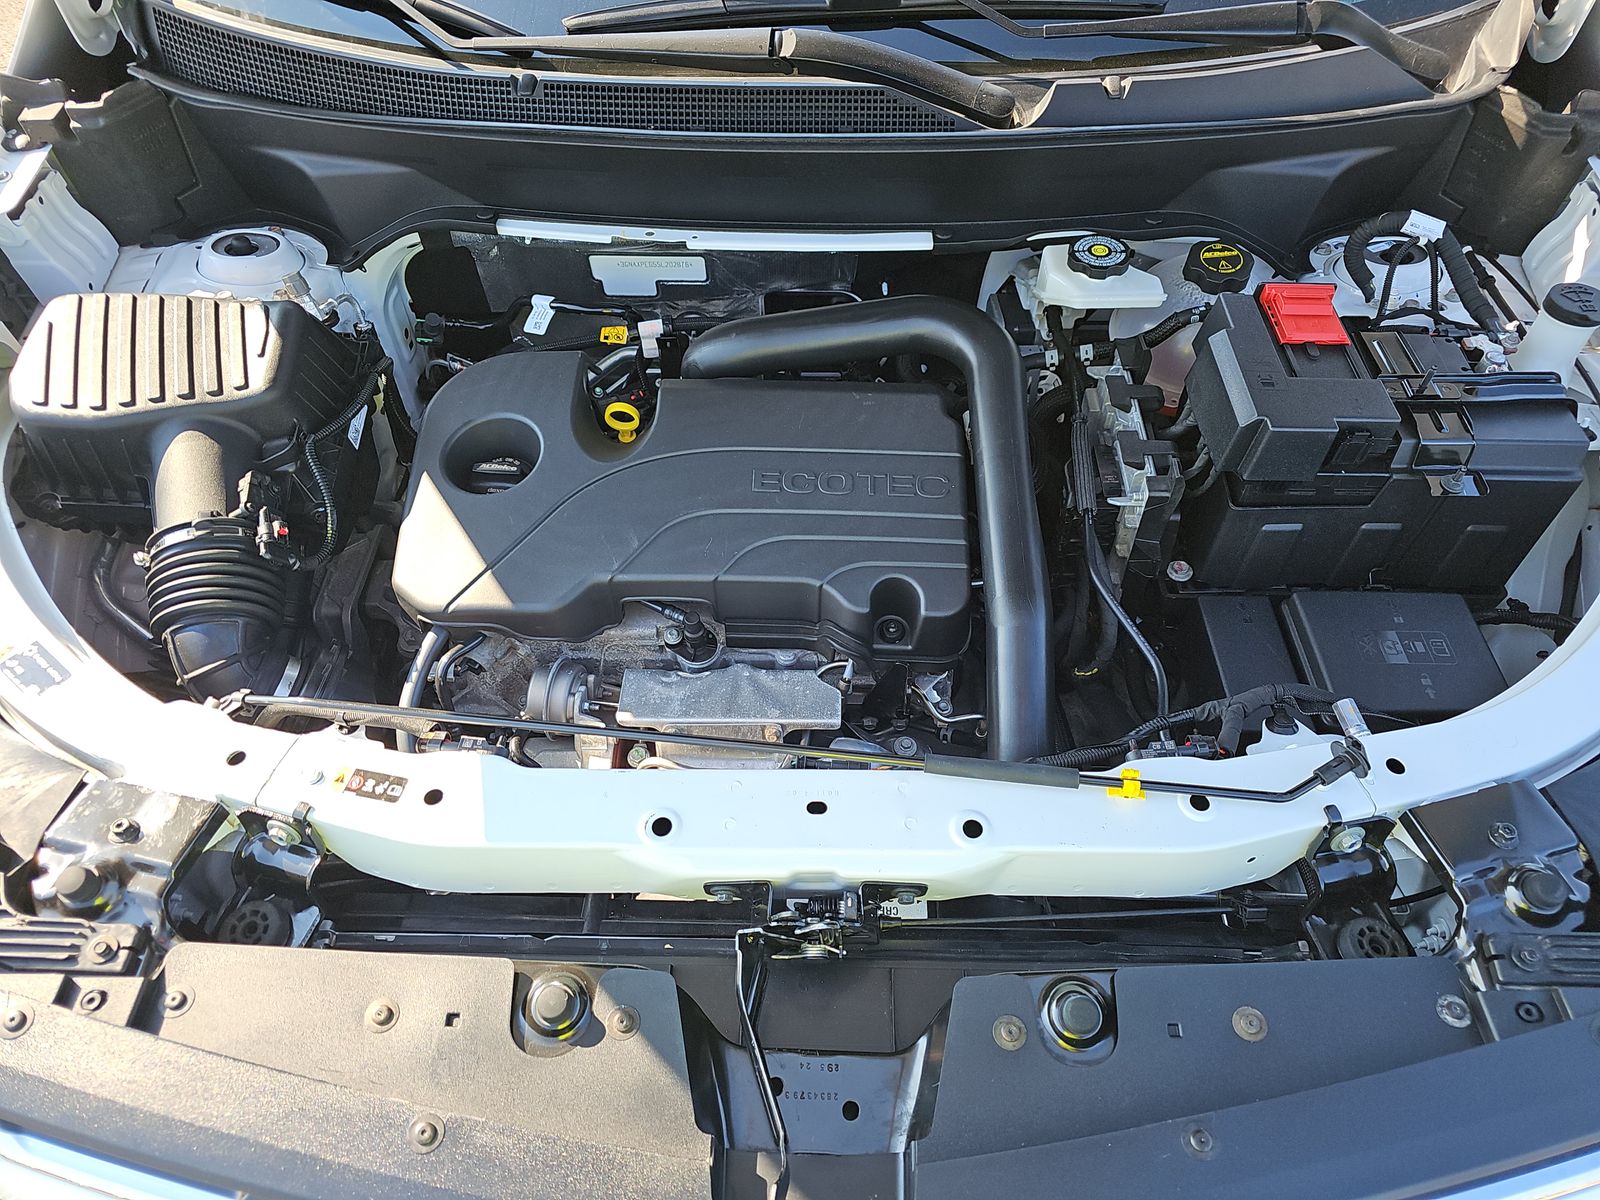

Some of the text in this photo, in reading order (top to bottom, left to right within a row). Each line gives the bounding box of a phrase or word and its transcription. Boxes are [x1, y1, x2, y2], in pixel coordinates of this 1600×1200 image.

[1202, 250, 1238, 259] ACDelco
[479, 463, 518, 472] ACDelco
[751, 469, 950, 499] ECOTEC
